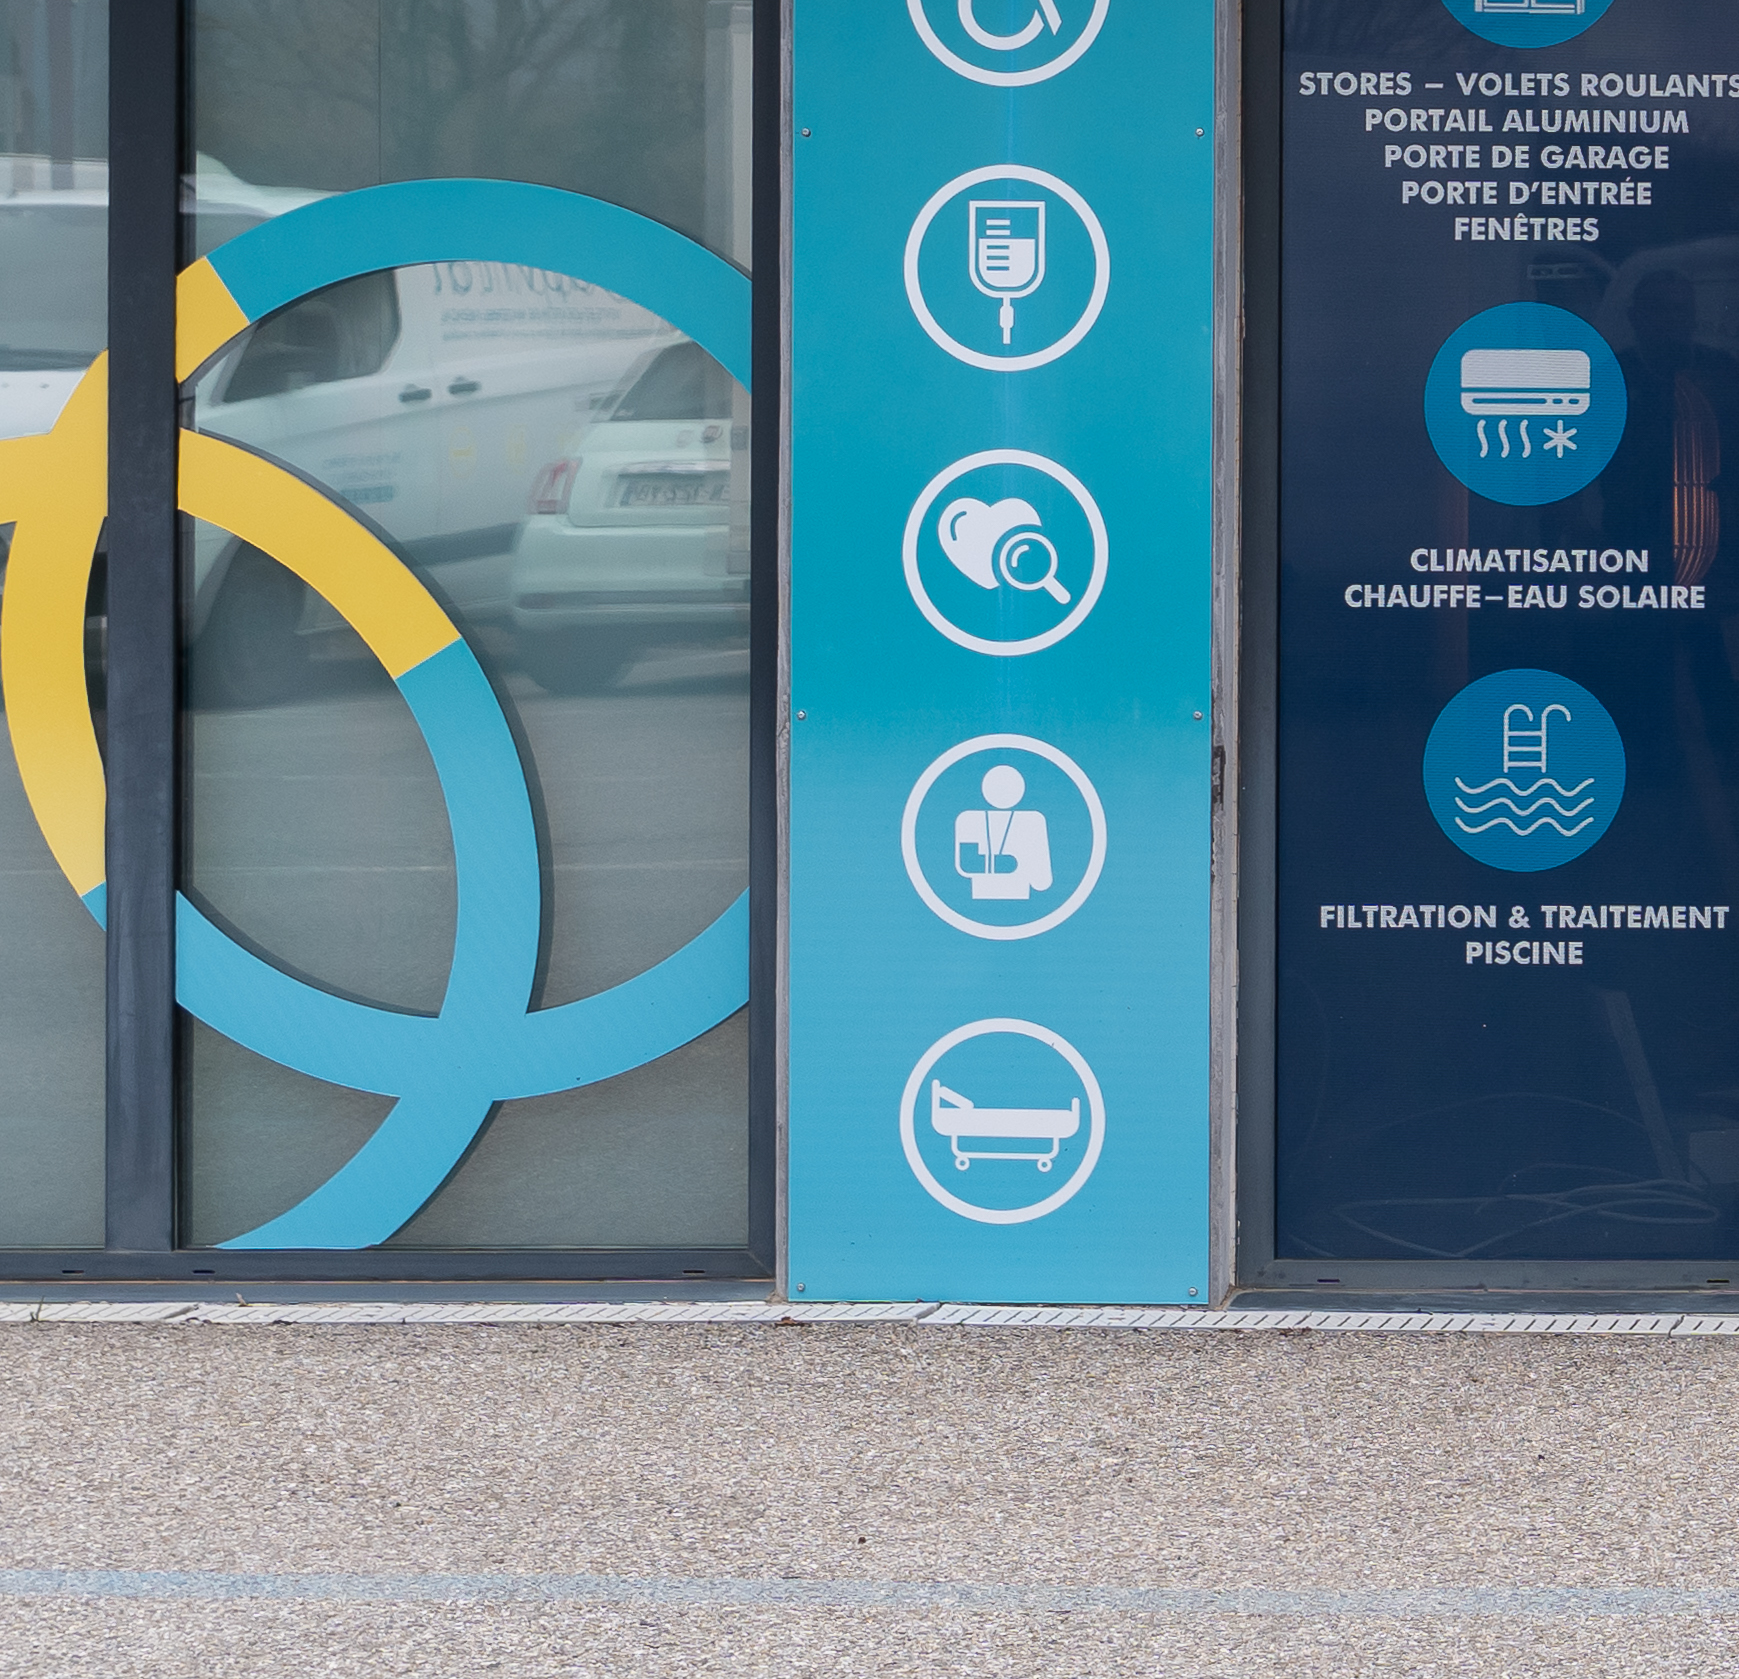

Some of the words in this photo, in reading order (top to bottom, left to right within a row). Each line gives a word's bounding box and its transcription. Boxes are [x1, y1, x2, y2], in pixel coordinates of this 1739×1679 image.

[1299, 72, 1412, 96] STORES
[1456, 73, 1570, 97] VOLETS
[1365, 109, 1493, 133] PORTAIL
[1502, 110, 1688, 135] ALUMINIUM
[1384, 145, 1481, 169] PORTE
[1491, 145, 1530, 169] DE
[1540, 145, 1669, 170] GARAGE
[1401, 181, 1497, 205] PORTE
[1455, 213, 1599, 242] FENÊTRES
[1411, 548, 1648, 573] CLIMATISATION
[1578, 585, 1705, 610] SOLAIRE
[1320, 905, 1497, 929] FILTRATION
[1508, 905, 1530, 929] &
[1541, 905, 1729, 930] TRAITEMENT
[1465, 941, 1583, 966] PISCINE
